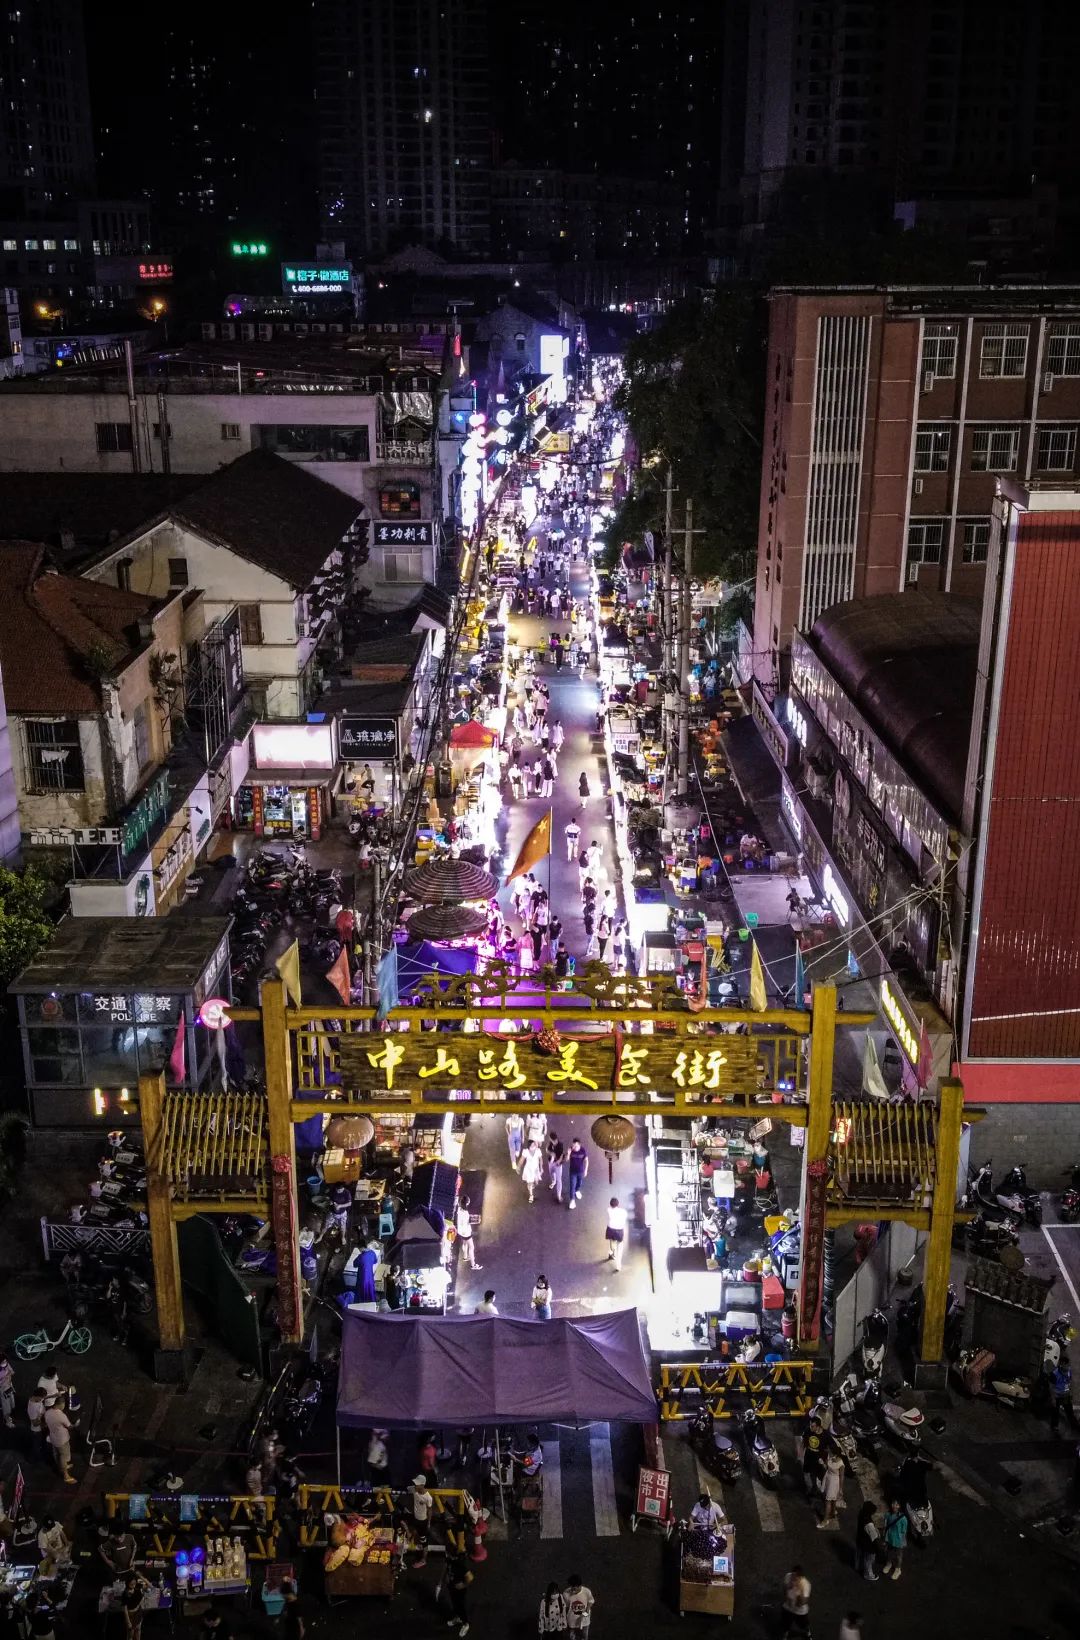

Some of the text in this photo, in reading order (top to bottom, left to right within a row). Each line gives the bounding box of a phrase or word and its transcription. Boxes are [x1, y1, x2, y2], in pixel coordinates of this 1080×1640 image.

[378, 526, 428, 542] 墨功刺青
[366, 1038, 728, 1091] 中山路美食街
[641, 1471, 655, 1496] 夜市
[656, 1474, 669, 1499] 出口
